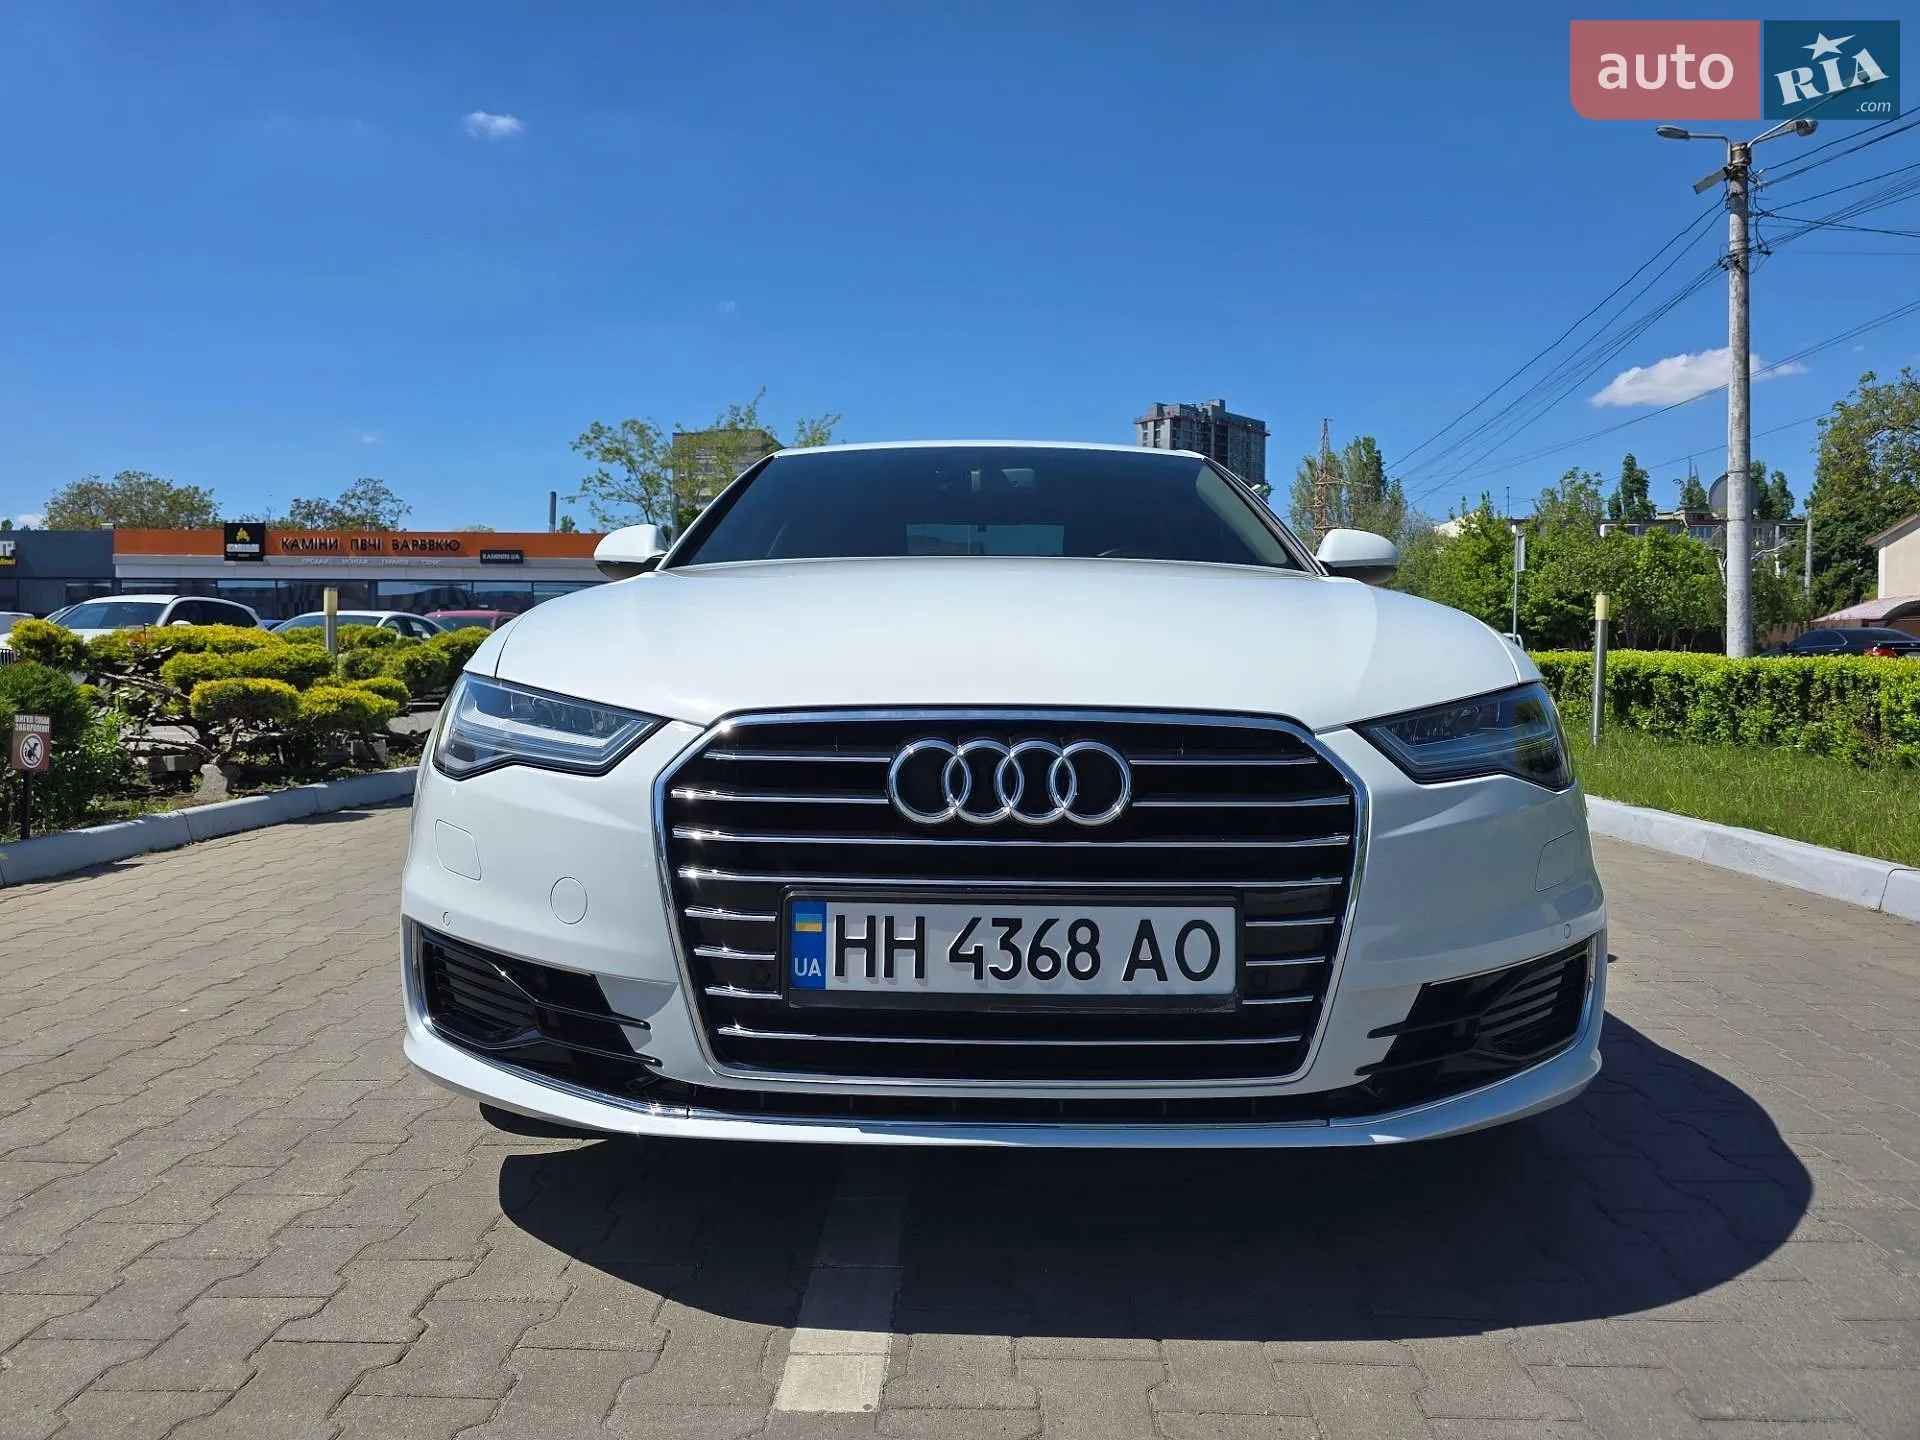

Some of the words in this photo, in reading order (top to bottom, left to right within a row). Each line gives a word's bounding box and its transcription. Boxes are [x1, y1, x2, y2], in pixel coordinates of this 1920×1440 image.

[281, 537, 339, 550] КАМІНИ
[350, 537, 383, 551] ПЕЧІ
[834, 914, 926, 979] HH
[947, 916, 1101, 981] 4368
[1121, 919, 1221, 982] AO
[794, 957, 823, 977] UA
